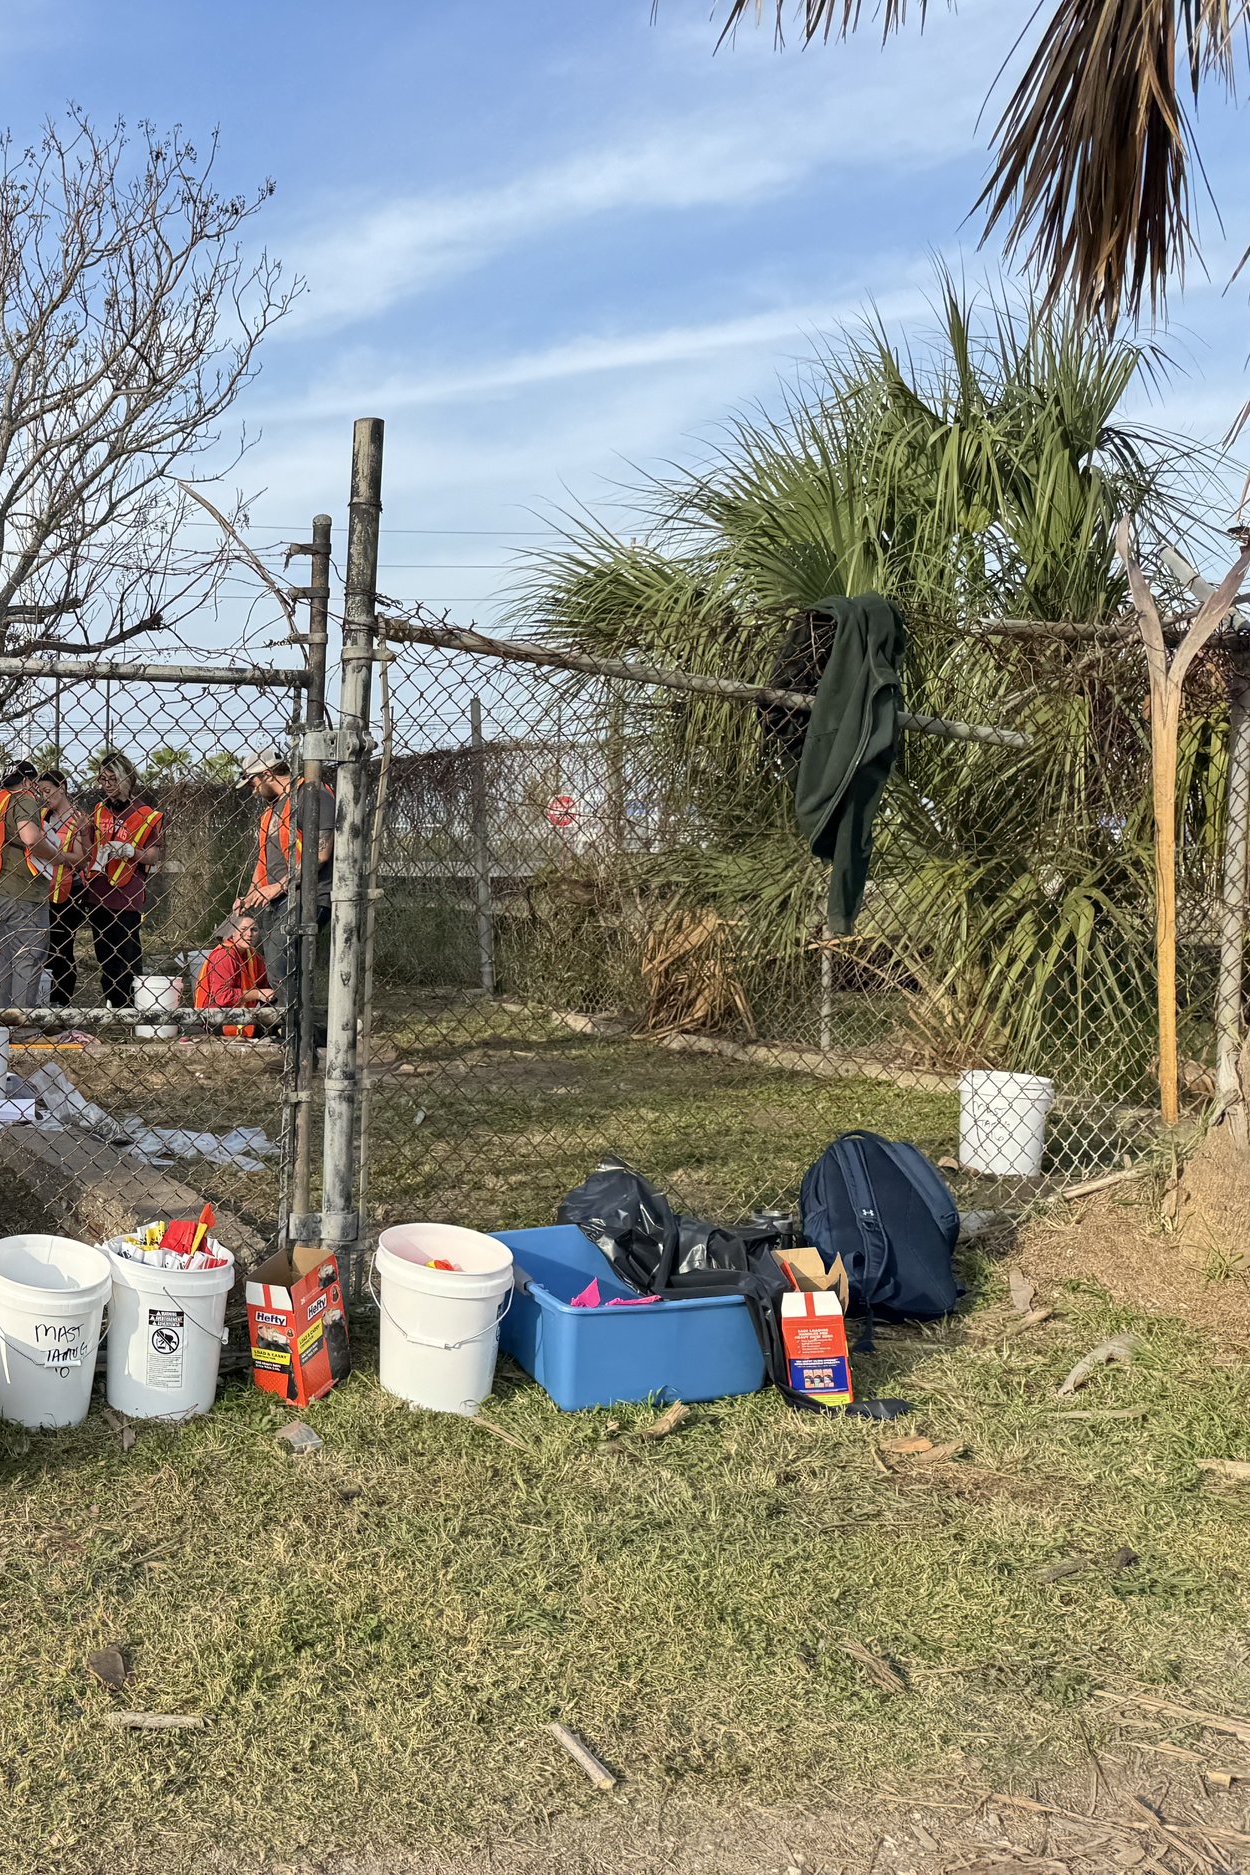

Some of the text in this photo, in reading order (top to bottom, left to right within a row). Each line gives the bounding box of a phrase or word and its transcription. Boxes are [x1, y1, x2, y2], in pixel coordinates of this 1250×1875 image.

[309, 1297, 326, 1317] Hefty
[257, 1312, 286, 1326] Hefty
[35, 1323, 85, 1343] MAST
